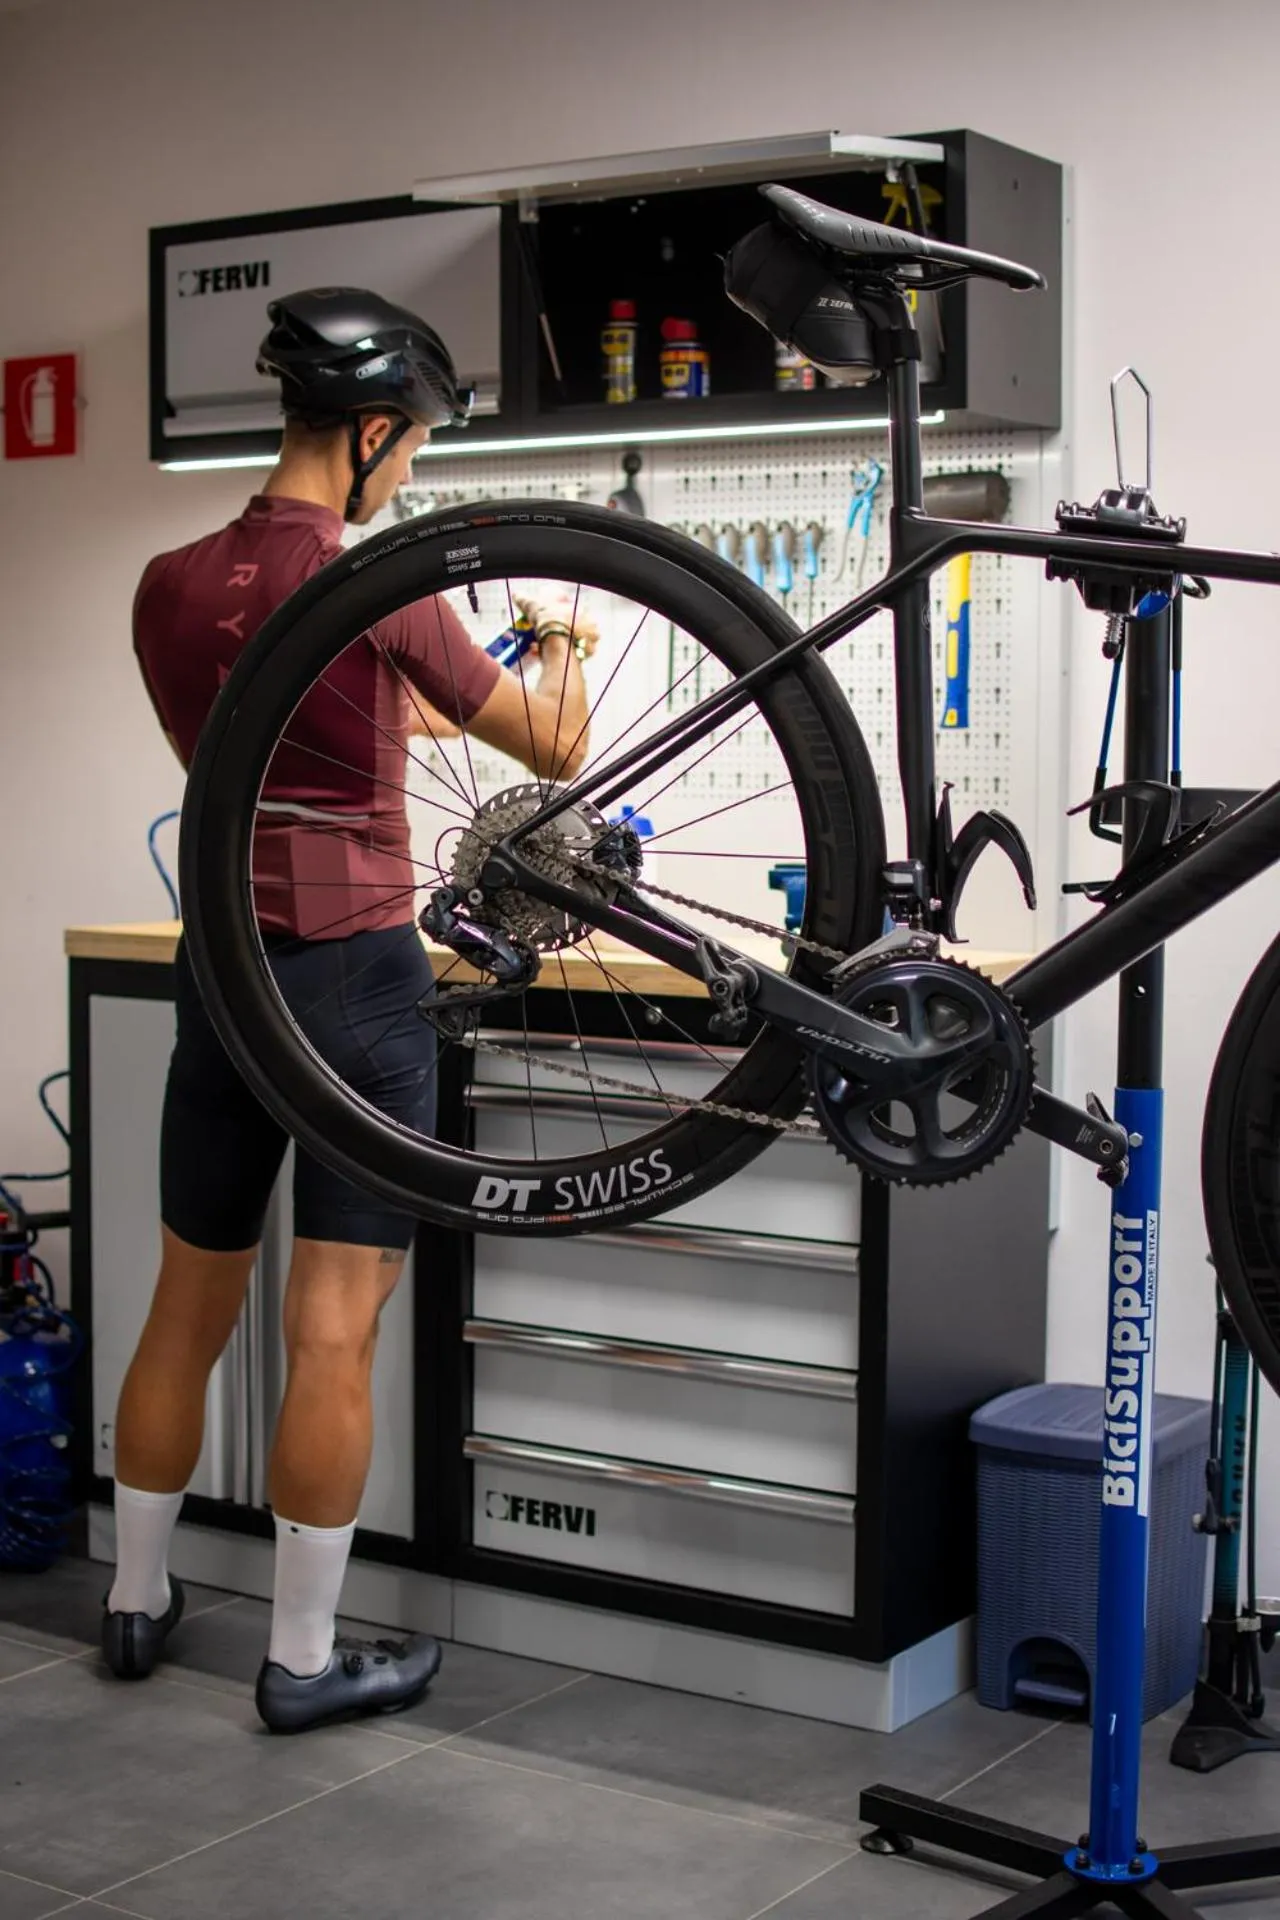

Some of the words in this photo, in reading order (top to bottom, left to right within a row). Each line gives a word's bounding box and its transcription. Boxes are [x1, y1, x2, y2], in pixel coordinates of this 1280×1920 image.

[198, 260, 270, 296] FERVI
[796, 1025, 891, 1064] ULTEGRA
[471, 1175, 541, 1212] DT
[554, 1148, 673, 1211] SWISS
[1148, 1218, 1156, 1250] ITALY
[1147, 1268, 1156, 1301] MADE
[1102, 1211, 1151, 1508] BiciSupport
[509, 1494, 597, 1537] FERVI
